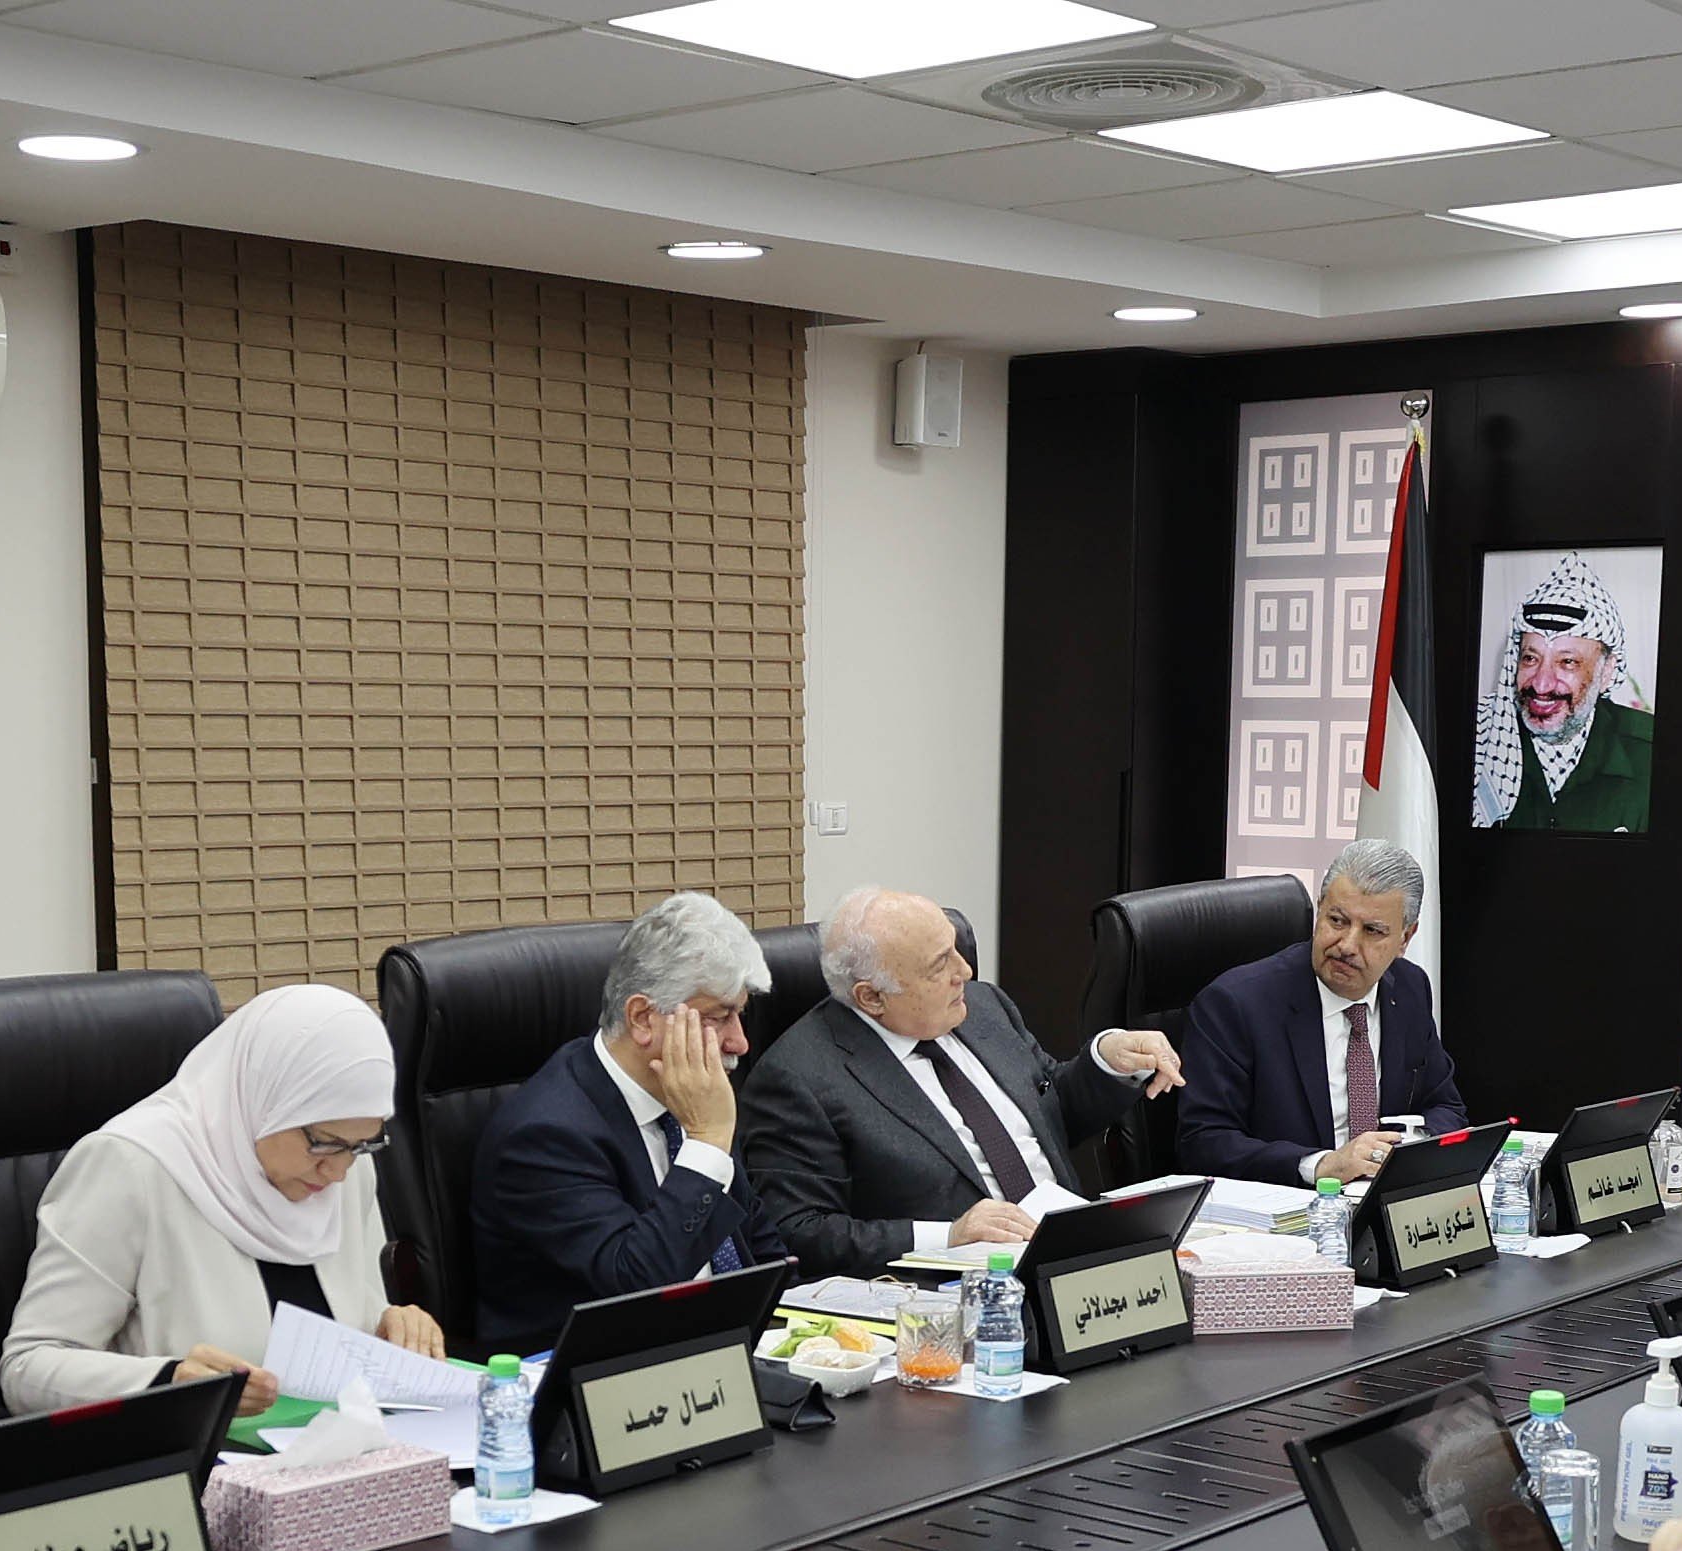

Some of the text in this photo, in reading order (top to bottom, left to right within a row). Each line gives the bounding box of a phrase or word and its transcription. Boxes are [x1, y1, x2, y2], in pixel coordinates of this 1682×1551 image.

[1587, 1166, 1644, 1206] أمجد غانم
[1404, 1206, 1476, 1249] شكري بشارة
[1075, 1275, 1168, 1335] أحمد مجدلاني
[625, 1379, 725, 1433] آمال حمد
